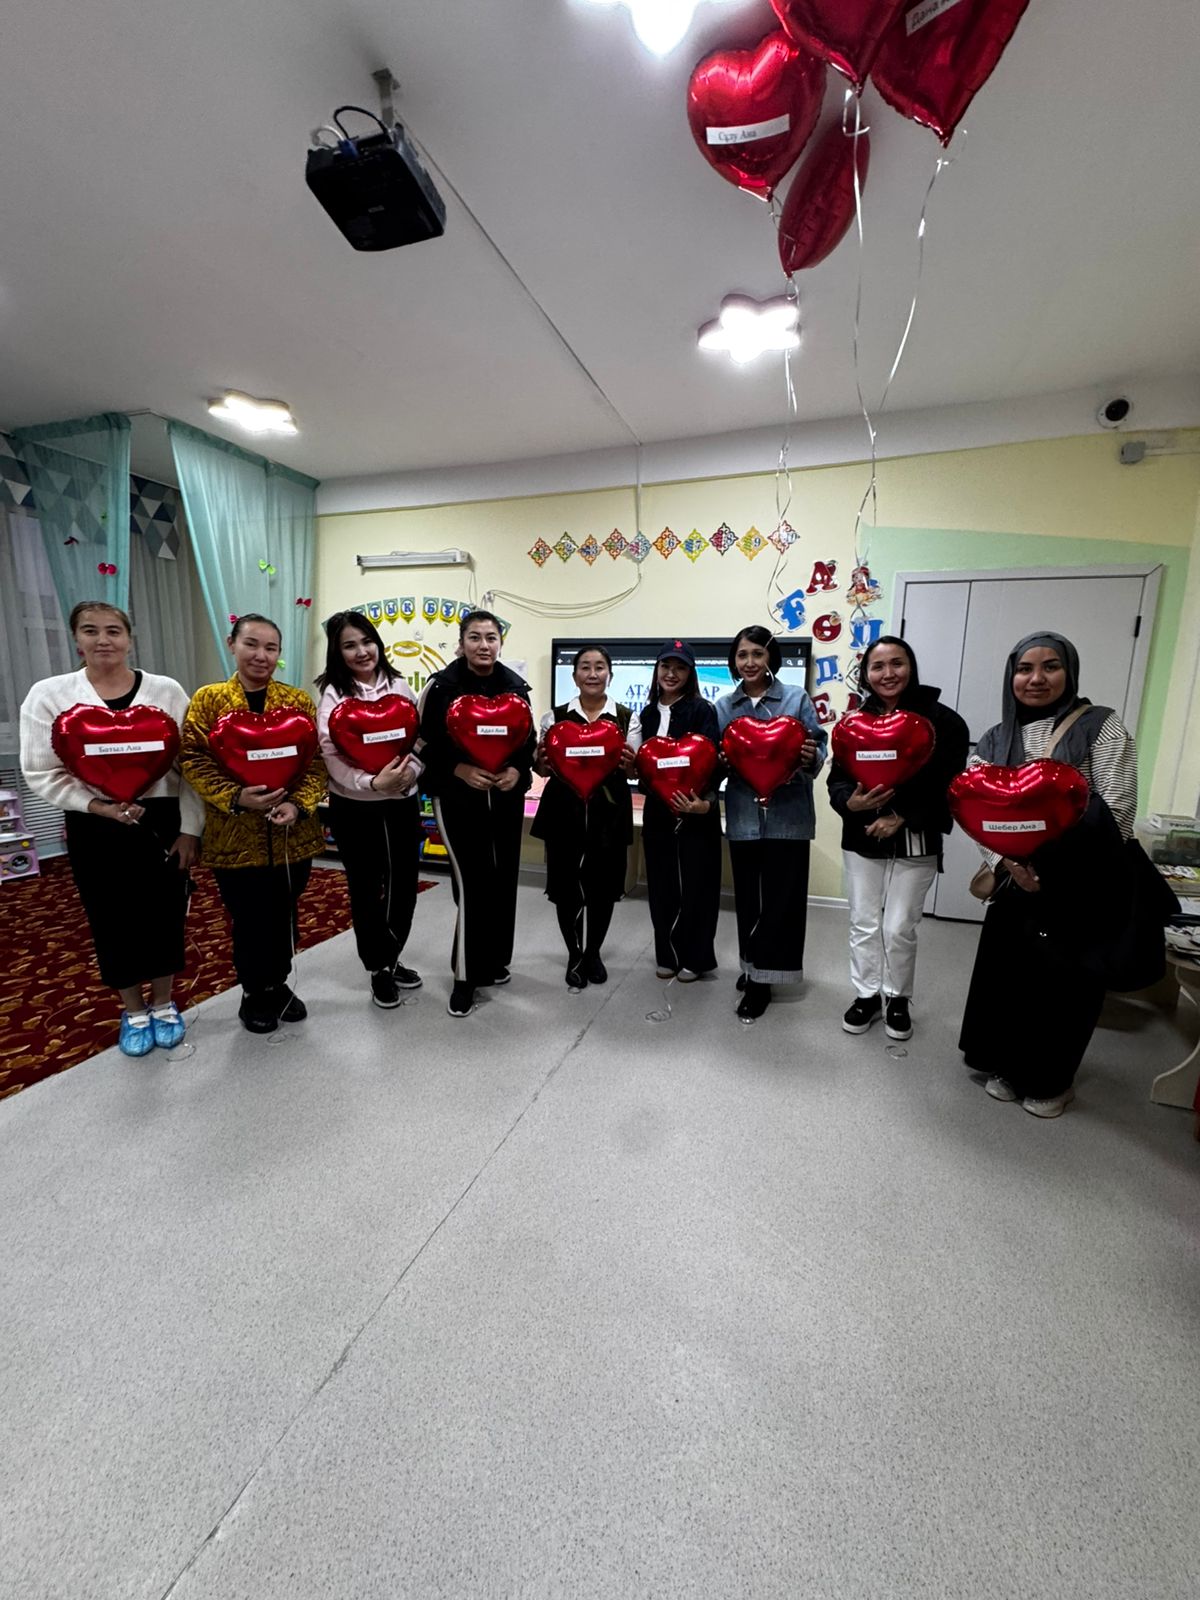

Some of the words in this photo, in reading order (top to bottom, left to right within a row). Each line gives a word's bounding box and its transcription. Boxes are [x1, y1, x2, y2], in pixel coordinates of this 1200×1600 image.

[740, 130, 757, 139] Ана
[667, 539, 675, 547] 6
[695, 540, 702, 550] 7
[754, 537, 761, 547] 9
[988, 823, 1018, 832] Шебер
